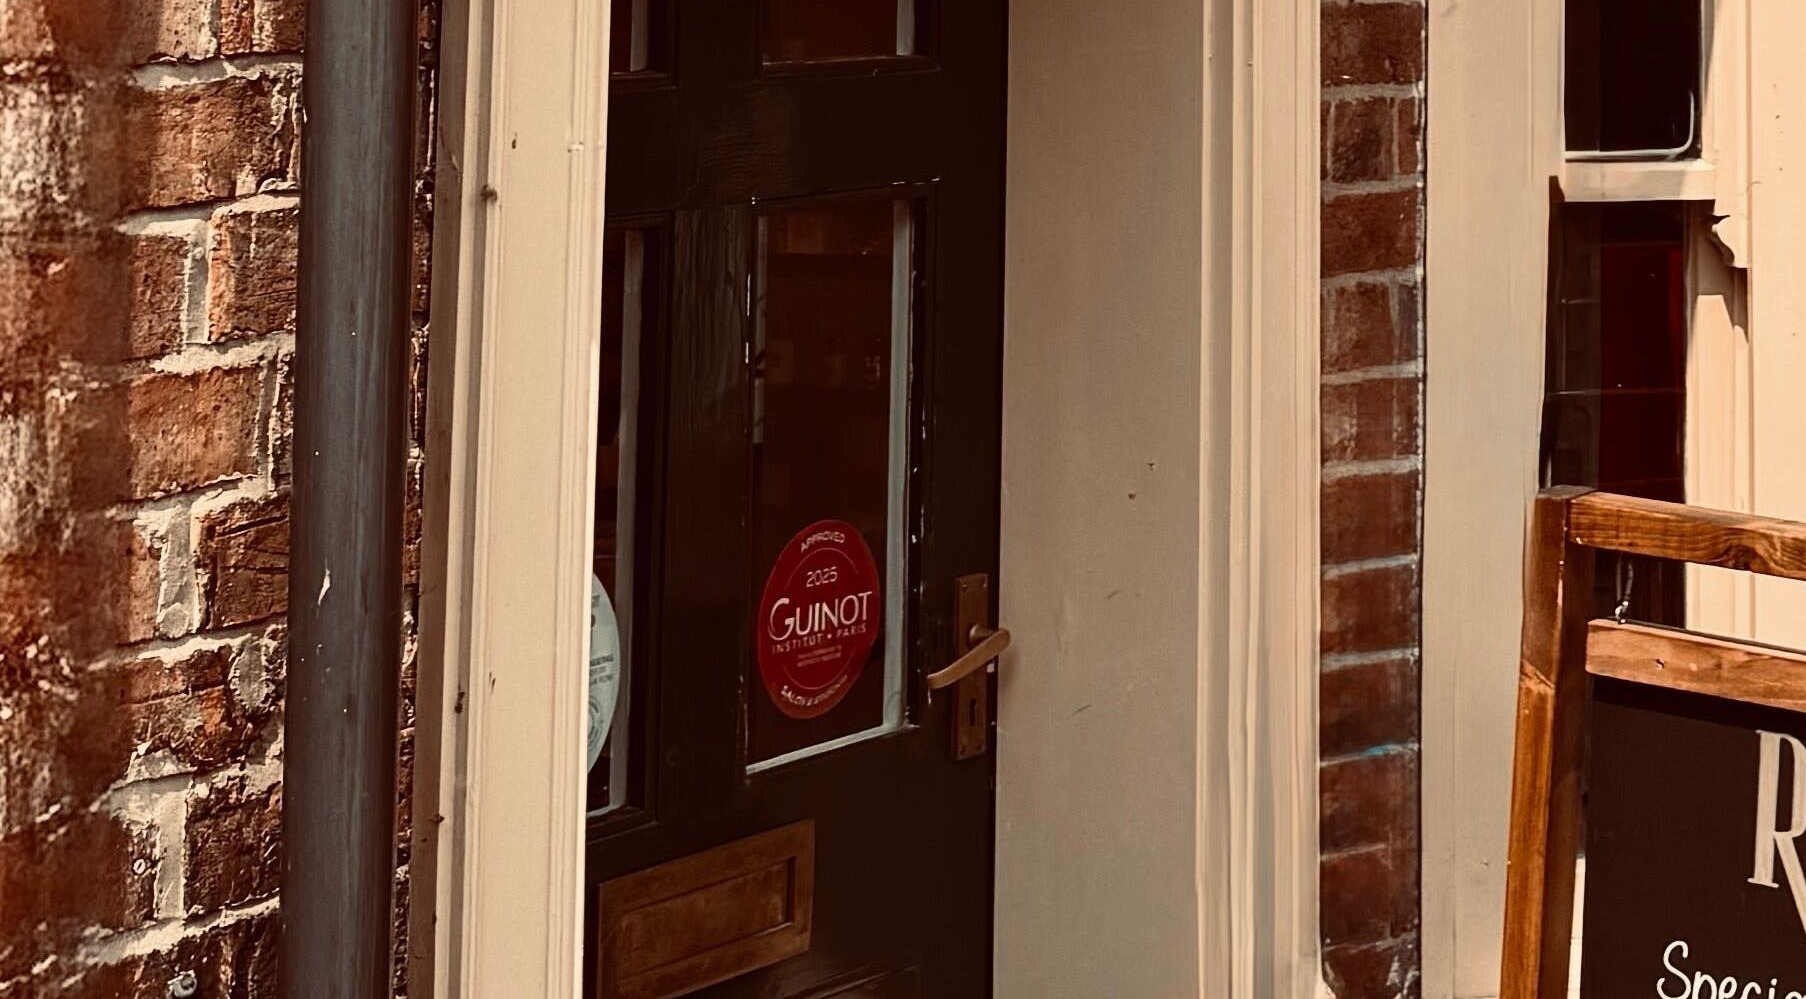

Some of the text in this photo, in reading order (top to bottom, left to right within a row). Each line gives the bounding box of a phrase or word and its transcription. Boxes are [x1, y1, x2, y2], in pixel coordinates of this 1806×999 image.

[806, 566, 838, 587] 2025
[768, 591, 872, 640] GUINOT
[771, 623, 866, 654] INSTITUT PARIS
